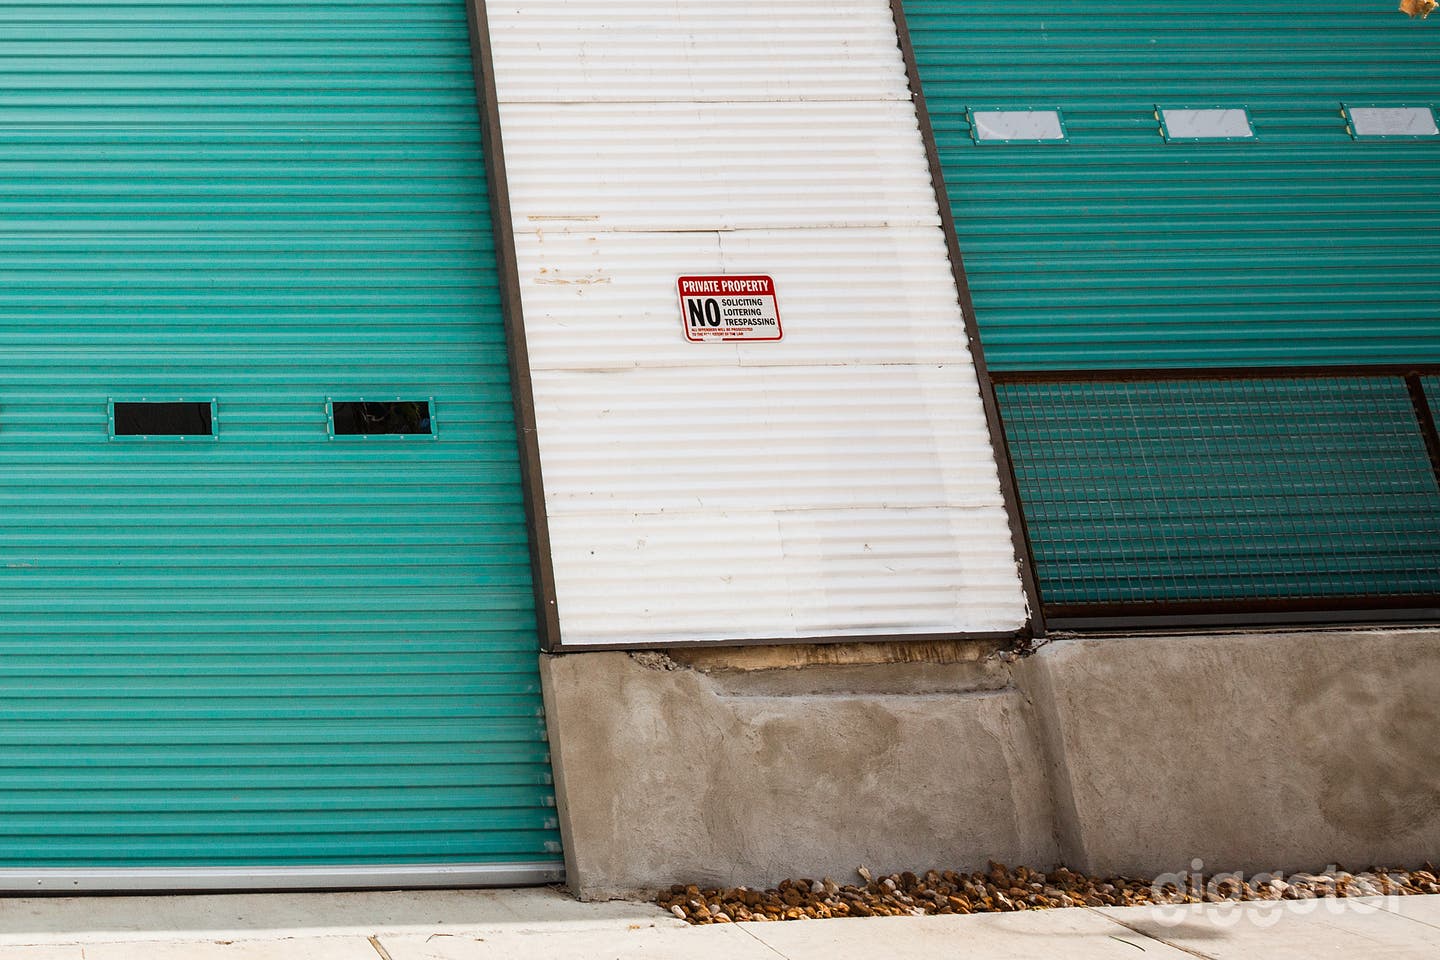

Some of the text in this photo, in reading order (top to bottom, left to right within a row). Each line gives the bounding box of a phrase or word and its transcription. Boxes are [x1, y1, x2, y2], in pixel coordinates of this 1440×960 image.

[682, 279, 769, 293] PRIVATE PROPERTY
[721, 298, 763, 307] SOLICITING
[687, 298, 721, 327] NO
[723, 308, 762, 317] LOITERING
[724, 318, 776, 326] TRESPASSING
